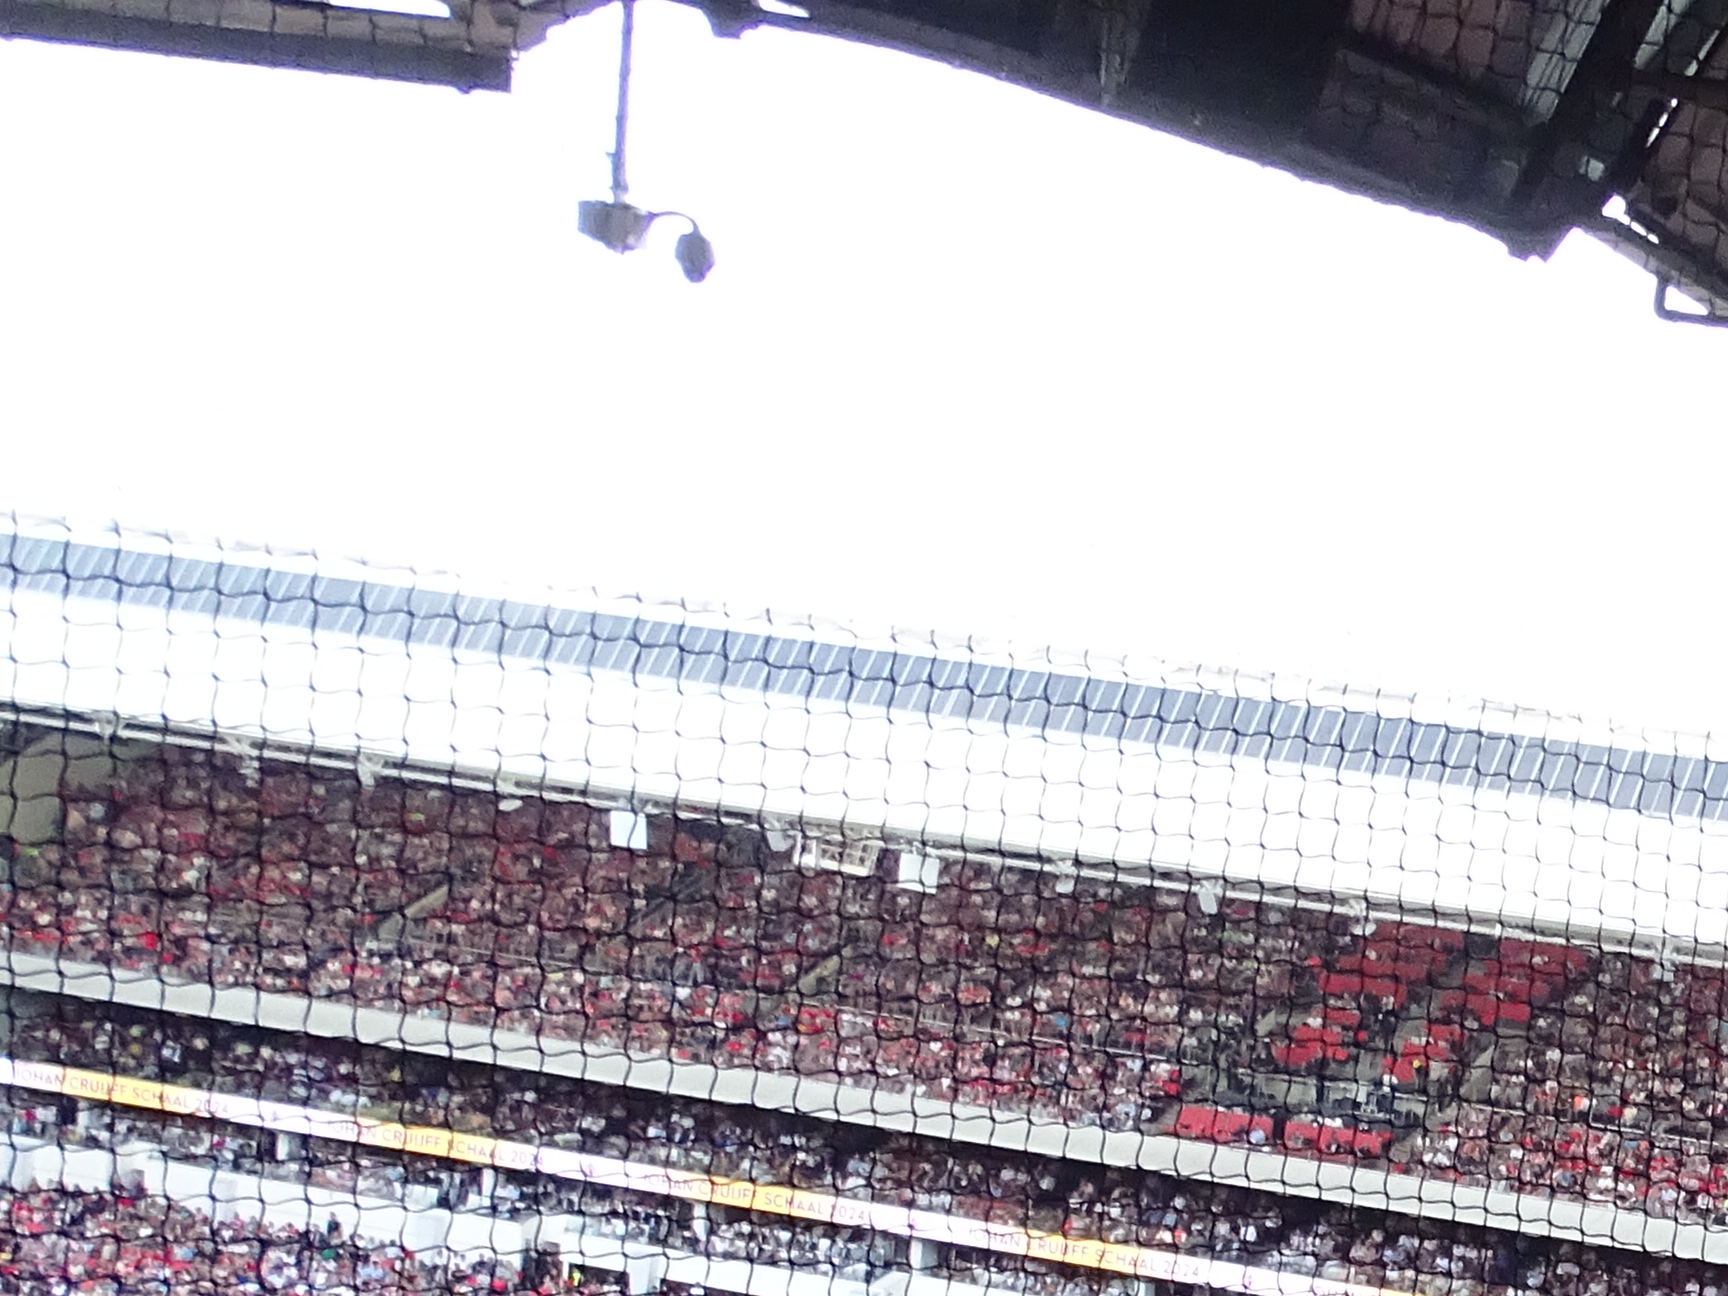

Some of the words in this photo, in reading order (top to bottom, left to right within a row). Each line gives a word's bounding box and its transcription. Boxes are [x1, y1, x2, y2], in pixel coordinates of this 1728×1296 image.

[15, 1068, 64, 1087] JOHAN
[132, 1086, 190, 1109] SCHAAL
[764, 1193, 824, 1216] SCHAAL
